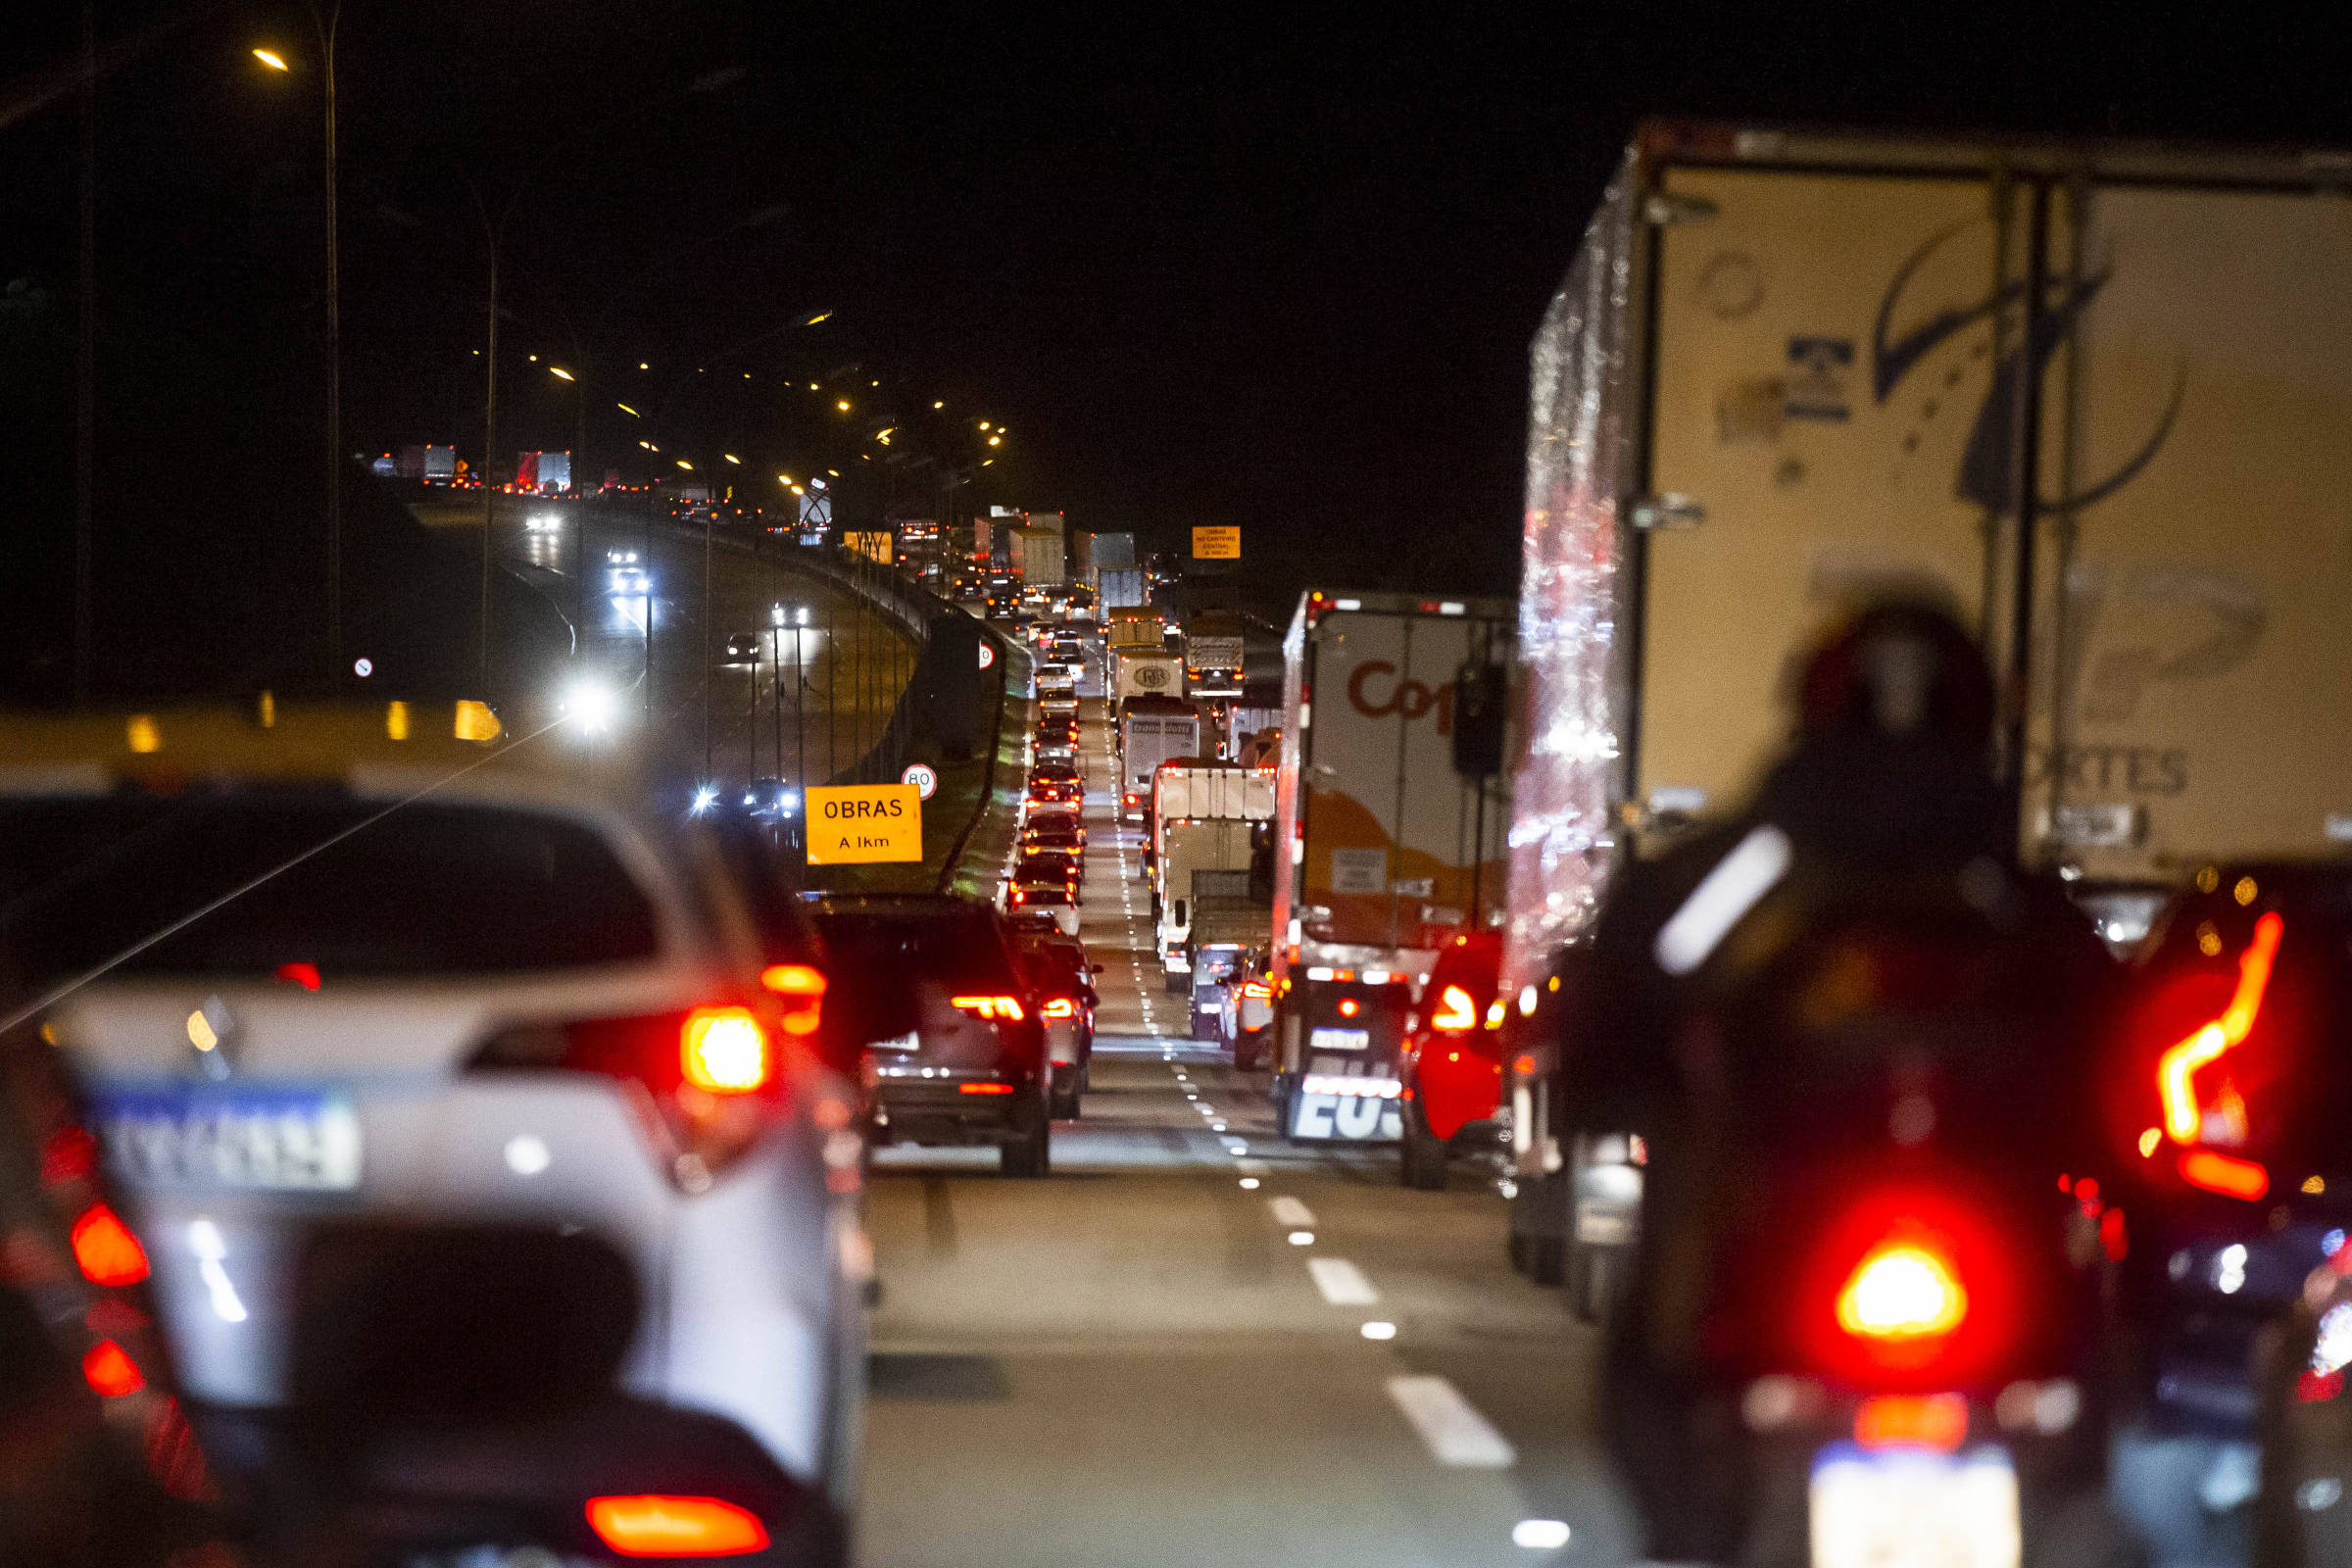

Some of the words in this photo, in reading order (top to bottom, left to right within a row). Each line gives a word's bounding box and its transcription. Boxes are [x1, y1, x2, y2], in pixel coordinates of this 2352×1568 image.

[908, 773, 930, 785] 80
[2023, 746, 2188, 798] ORTES
[824, 799, 903, 819] OBRAS
[839, 837, 850, 849] A
[858, 836, 890, 848] 1km
